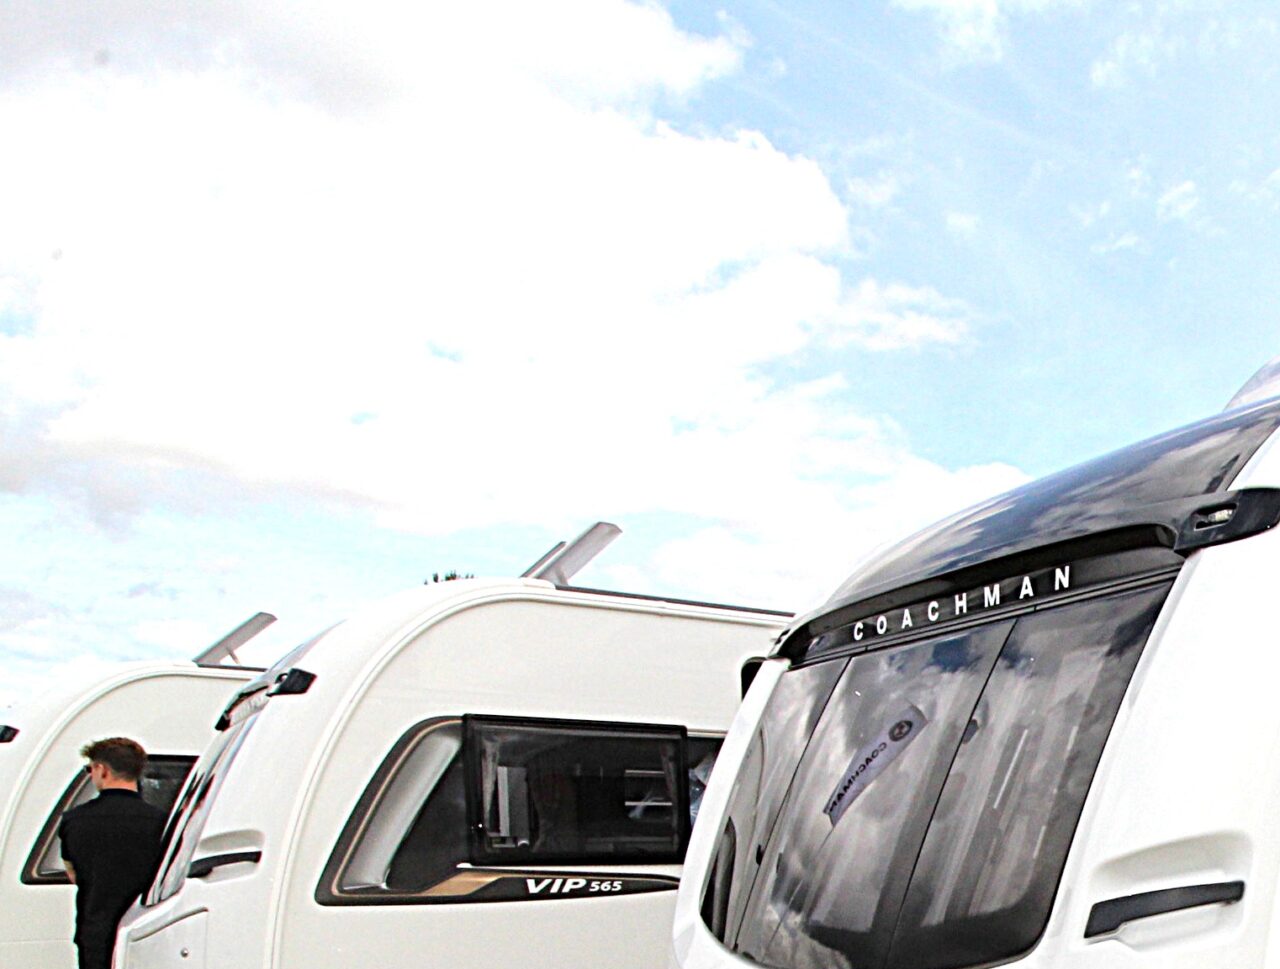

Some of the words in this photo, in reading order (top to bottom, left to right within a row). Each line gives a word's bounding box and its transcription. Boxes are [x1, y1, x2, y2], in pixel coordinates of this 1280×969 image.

[853, 565, 1071, 641] COACHMAN
[525, 878, 587, 894] VIP
[588, 880, 623, 892] 565
